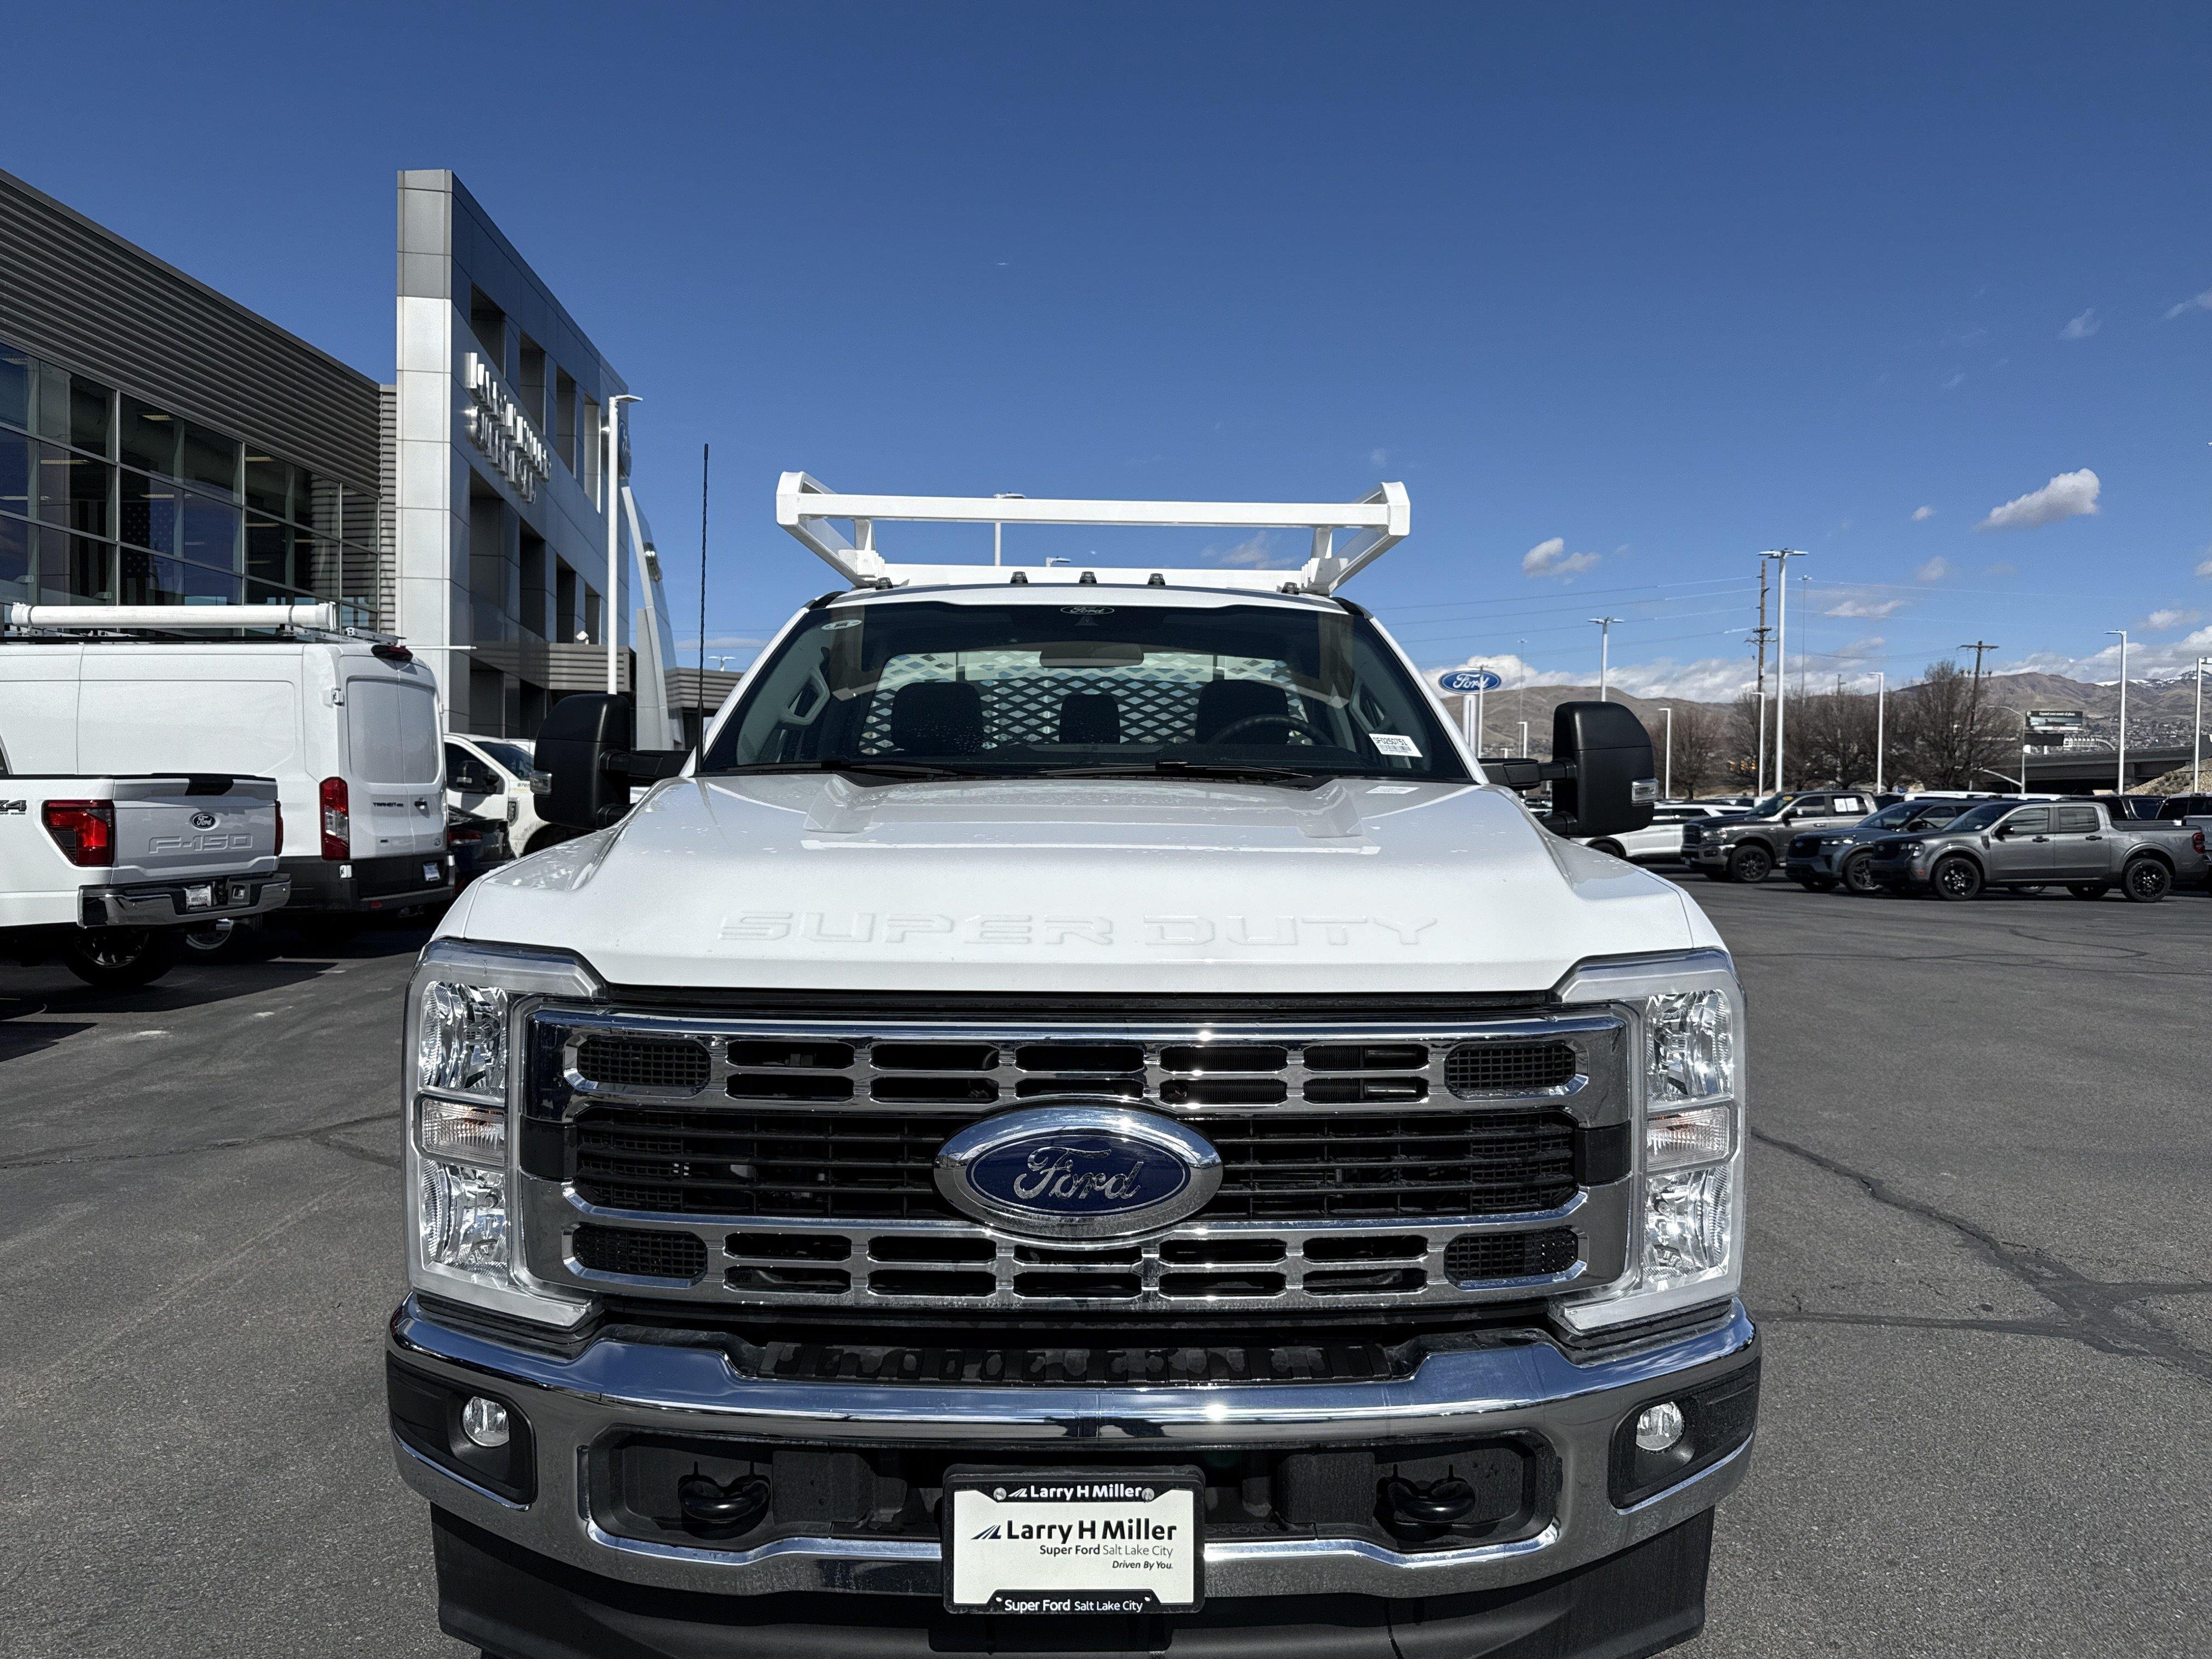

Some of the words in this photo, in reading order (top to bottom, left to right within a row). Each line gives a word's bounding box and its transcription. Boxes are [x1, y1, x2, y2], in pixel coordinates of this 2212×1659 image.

[1453, 673, 1489, 689] Ford
[1373, 737, 1408, 746] SF0250751
[196, 815, 212, 826] Ford
[149, 833, 253, 854] F-150
[718, 911, 1113, 945] SUPER
[1143, 915, 1437, 945] DUTY
[1013, 1146, 1145, 1200] Ford
[1030, 1485, 1074, 1501] Larry
[1077, 1485, 1090, 1498] H
[1092, 1483, 1142, 1498] Miller
[1007, 1520, 1073, 1544] Larry
[1078, 1520, 1096, 1539] H
[1101, 1517, 1177, 1541] Miller
[1039, 1544, 1073, 1557] Super
[1075, 1544, 1100, 1555] Ford
[1103, 1544, 1122, 1555] Salt
[1125, 1545, 1150, 1556] Lake
[1152, 1545, 1173, 1559] City
[1112, 1560, 1141, 1569] Driven
[1144, 1561, 1154, 1571] By
[1156, 1561, 1173, 1570] You.
[1005, 1599, 1040, 1613] Super
[1043, 1599, 1070, 1611] Ford
[1074, 1600, 1094, 1611] Salt
[1097, 1600, 1121, 1611] Lake
[1122, 1599, 1143, 1613] City
